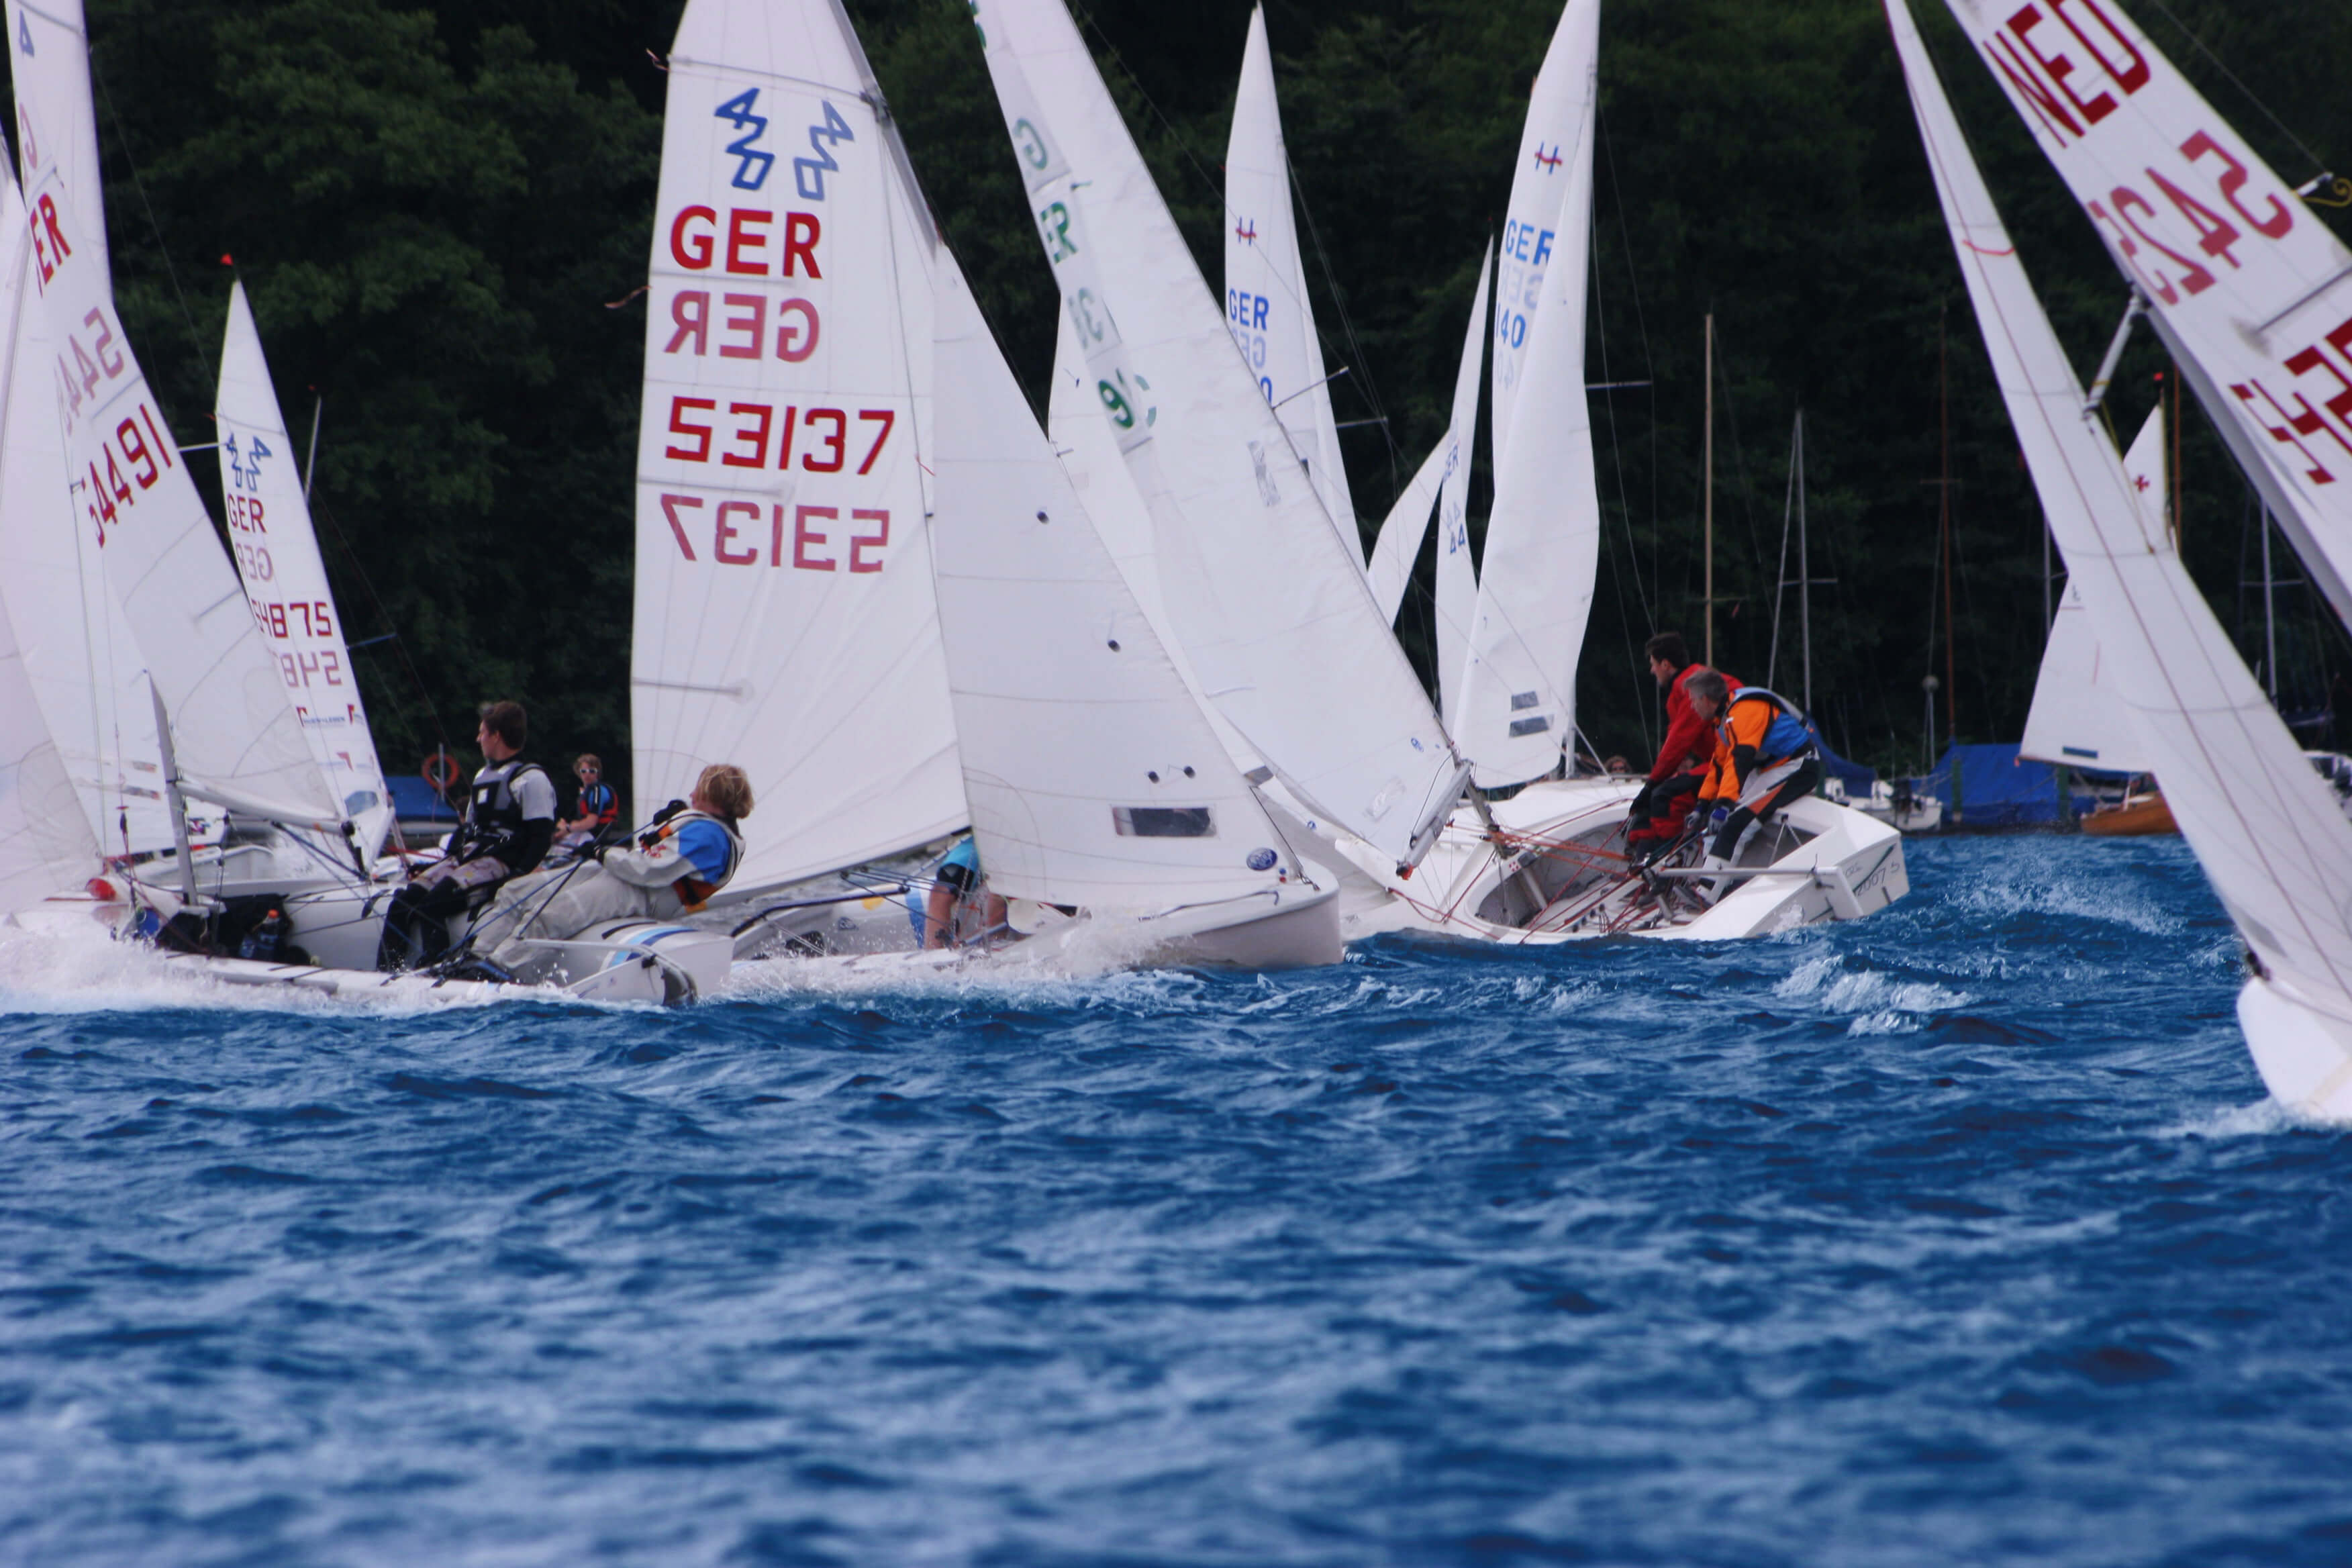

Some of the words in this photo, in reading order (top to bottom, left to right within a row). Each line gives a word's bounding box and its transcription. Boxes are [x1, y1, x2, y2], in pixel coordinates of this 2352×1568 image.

[29, 192, 72, 299] ER
[670, 205, 823, 279] GER
[1229, 288, 1269, 331] GER
[665, 395, 895, 475] 53137
[228, 493, 268, 534] GER
